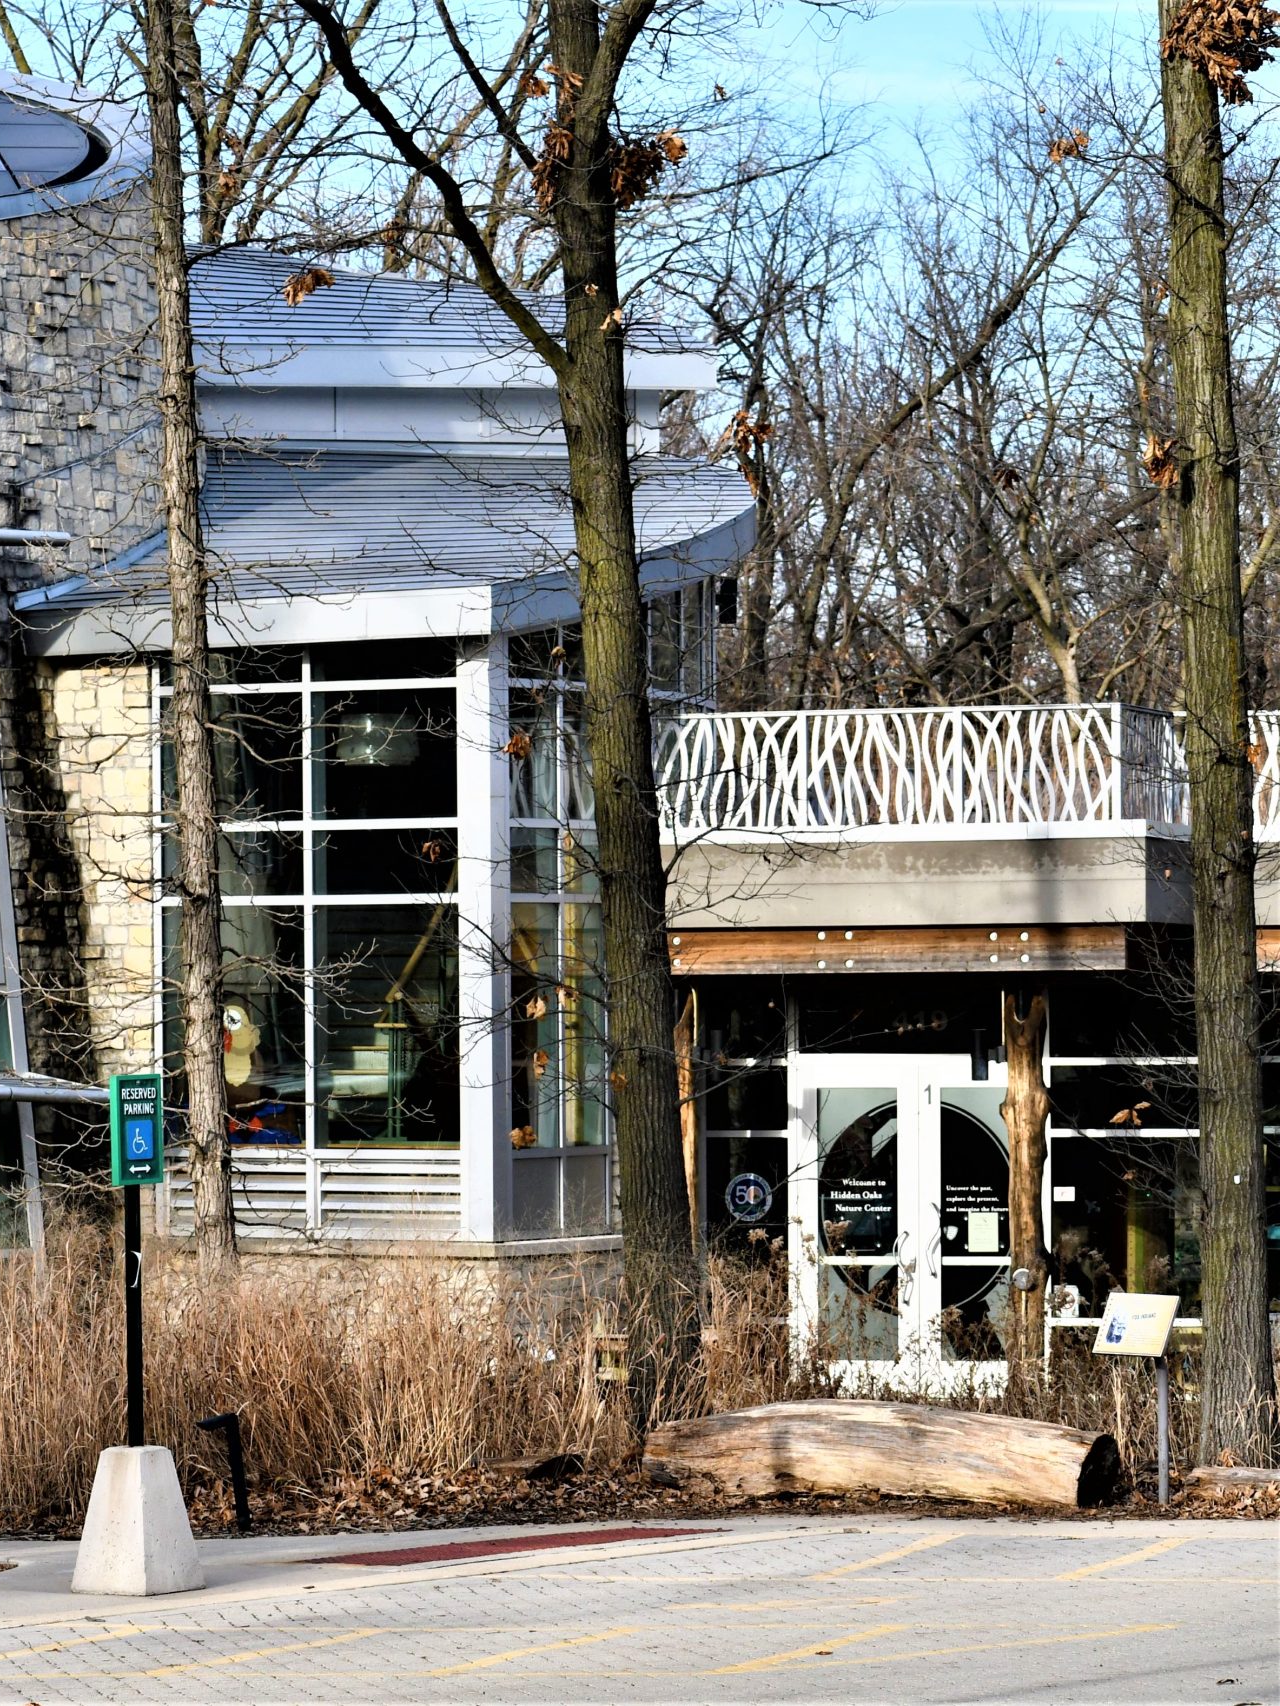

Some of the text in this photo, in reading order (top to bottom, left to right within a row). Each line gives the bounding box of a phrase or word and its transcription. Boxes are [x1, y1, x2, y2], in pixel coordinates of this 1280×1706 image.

[891, 1009, 949, 1032] 419
[121, 1087, 157, 1100] RESERVED
[923, 1084, 932, 1104] 1
[123, 1102, 155, 1115] PARKING
[842, 1178, 876, 1186] Welcome
[735, 1185, 763, 1205] 50
[830, 1190, 883, 1199] Hidden Oaks
[835, 1203, 892, 1212] Nature Center
